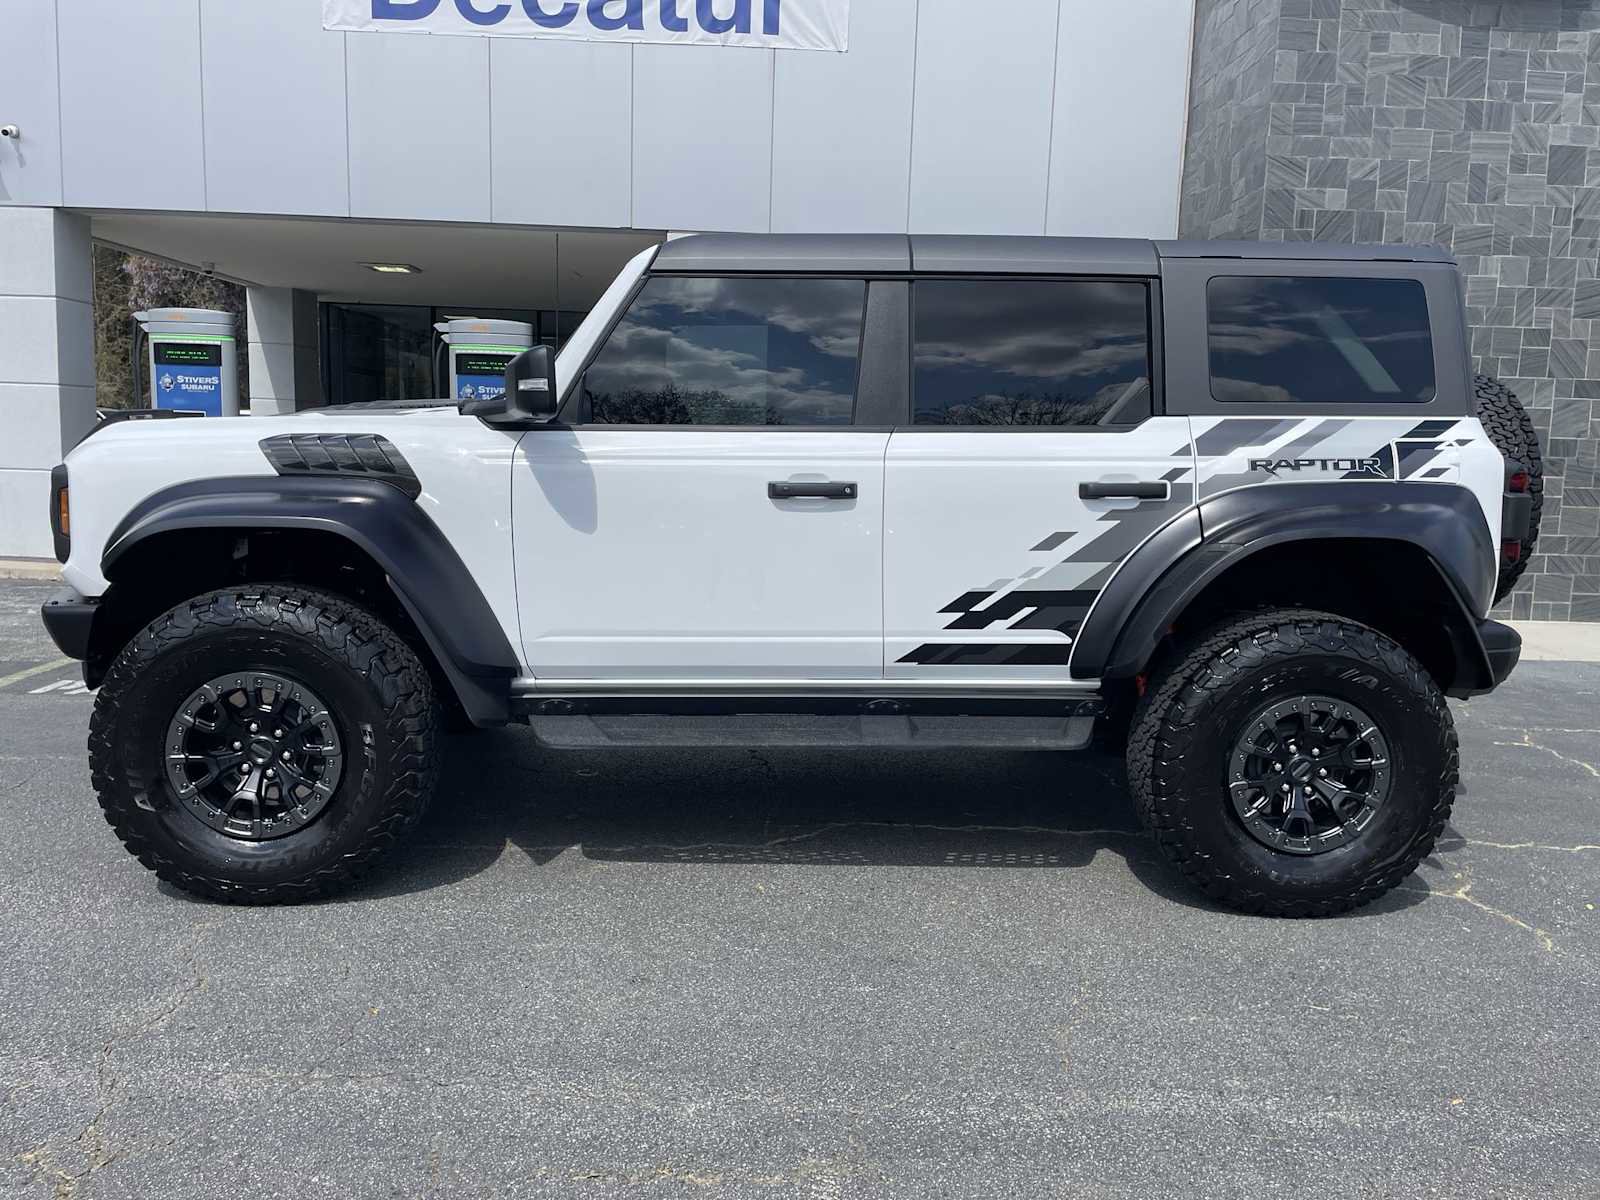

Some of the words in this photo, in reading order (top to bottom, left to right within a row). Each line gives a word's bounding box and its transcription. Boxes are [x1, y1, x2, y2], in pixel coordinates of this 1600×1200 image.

[371, 0, 780, 36] atur
[181, 383, 215, 391] SUBARU
[1248, 457, 1389, 479] RAPTOR
